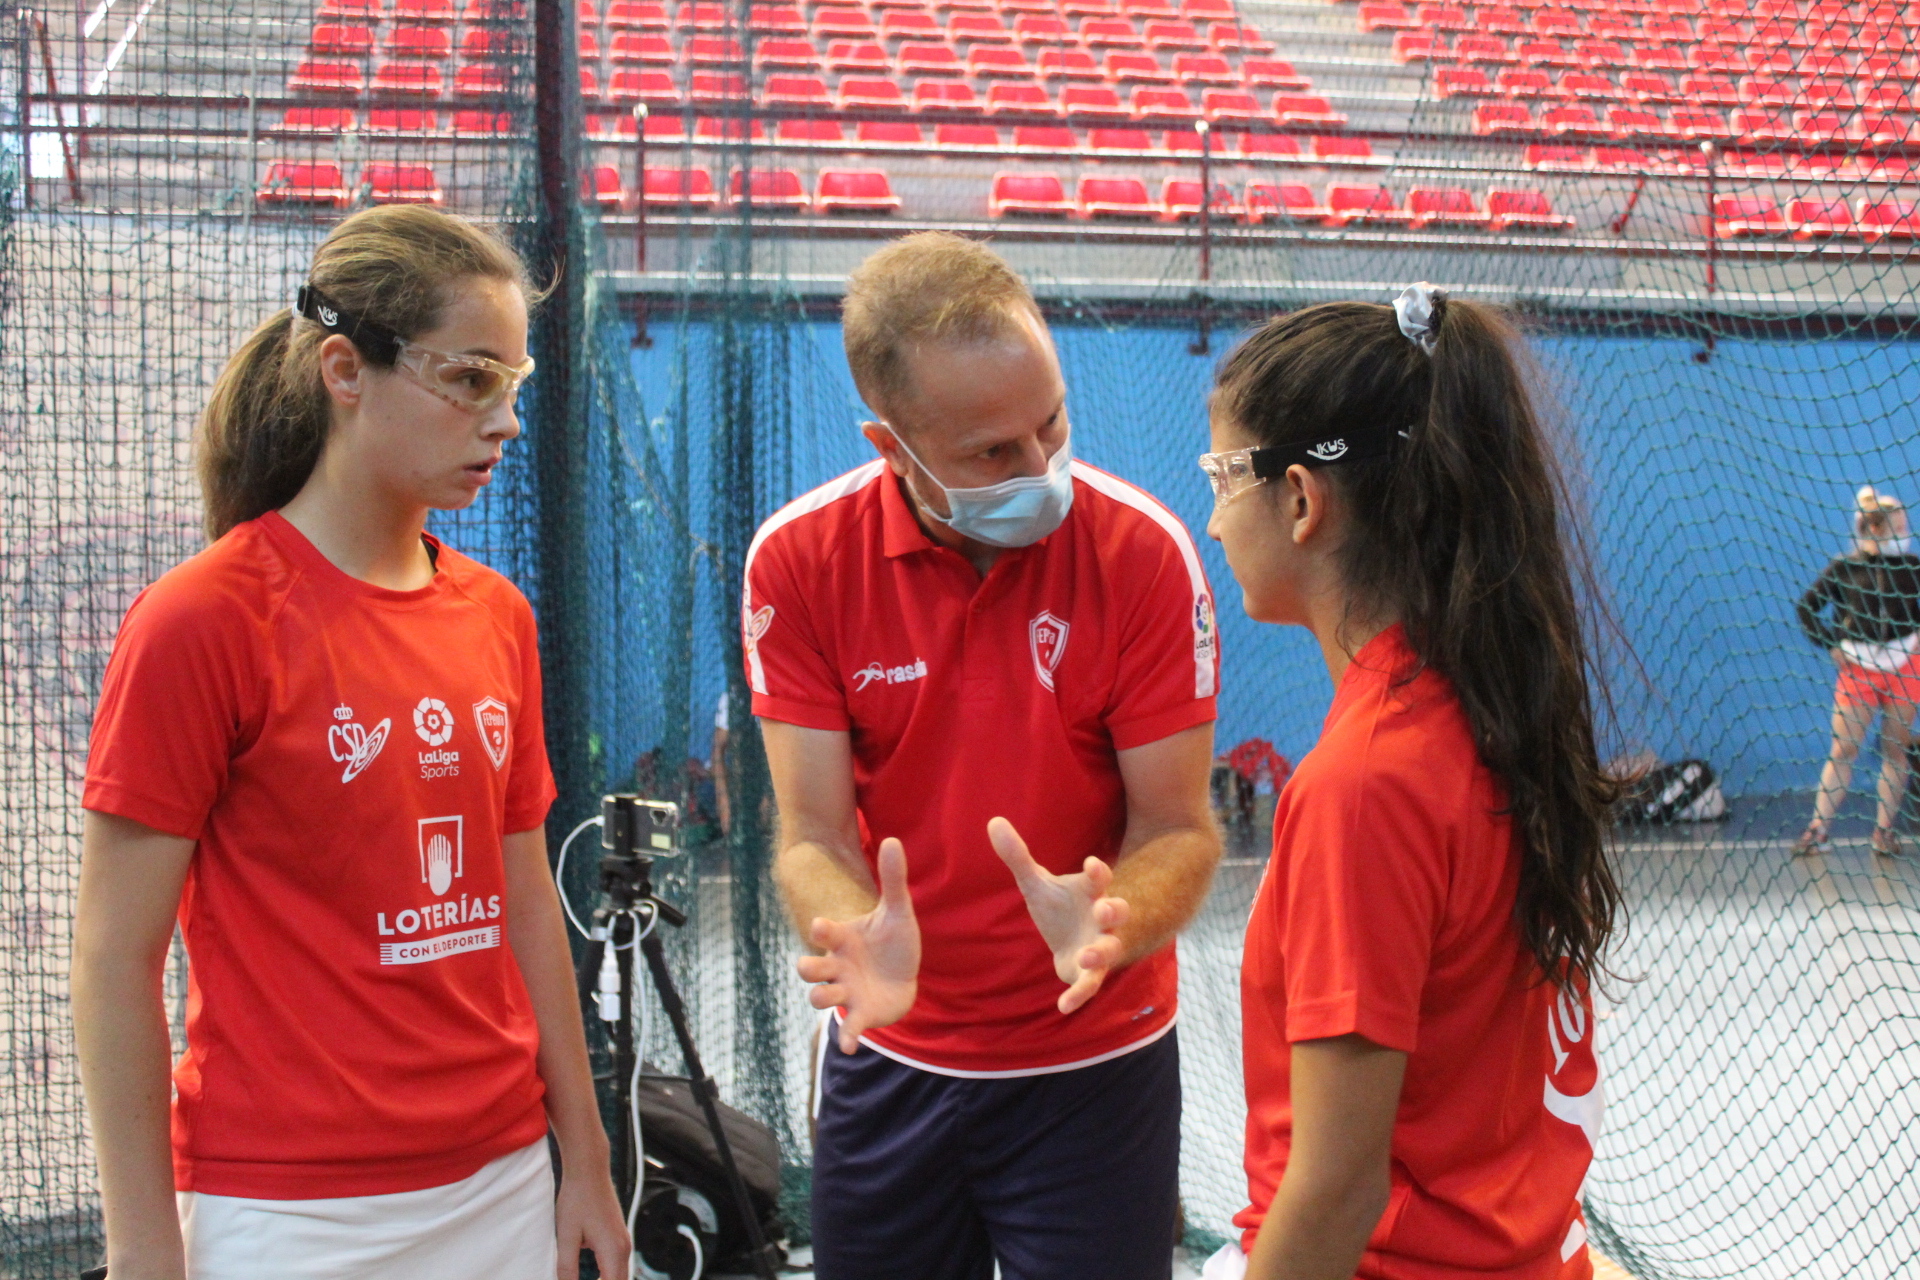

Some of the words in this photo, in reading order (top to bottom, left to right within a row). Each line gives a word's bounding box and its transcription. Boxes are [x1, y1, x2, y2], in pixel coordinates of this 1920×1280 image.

[328, 722, 368, 763] CSD
[418, 749, 460, 766] LaLiga
[420, 763, 460, 782] Sports
[377, 893, 501, 936] LOTERÍAS
[399, 946, 430, 959] CON
[442, 933, 488, 951] DEPORTE
